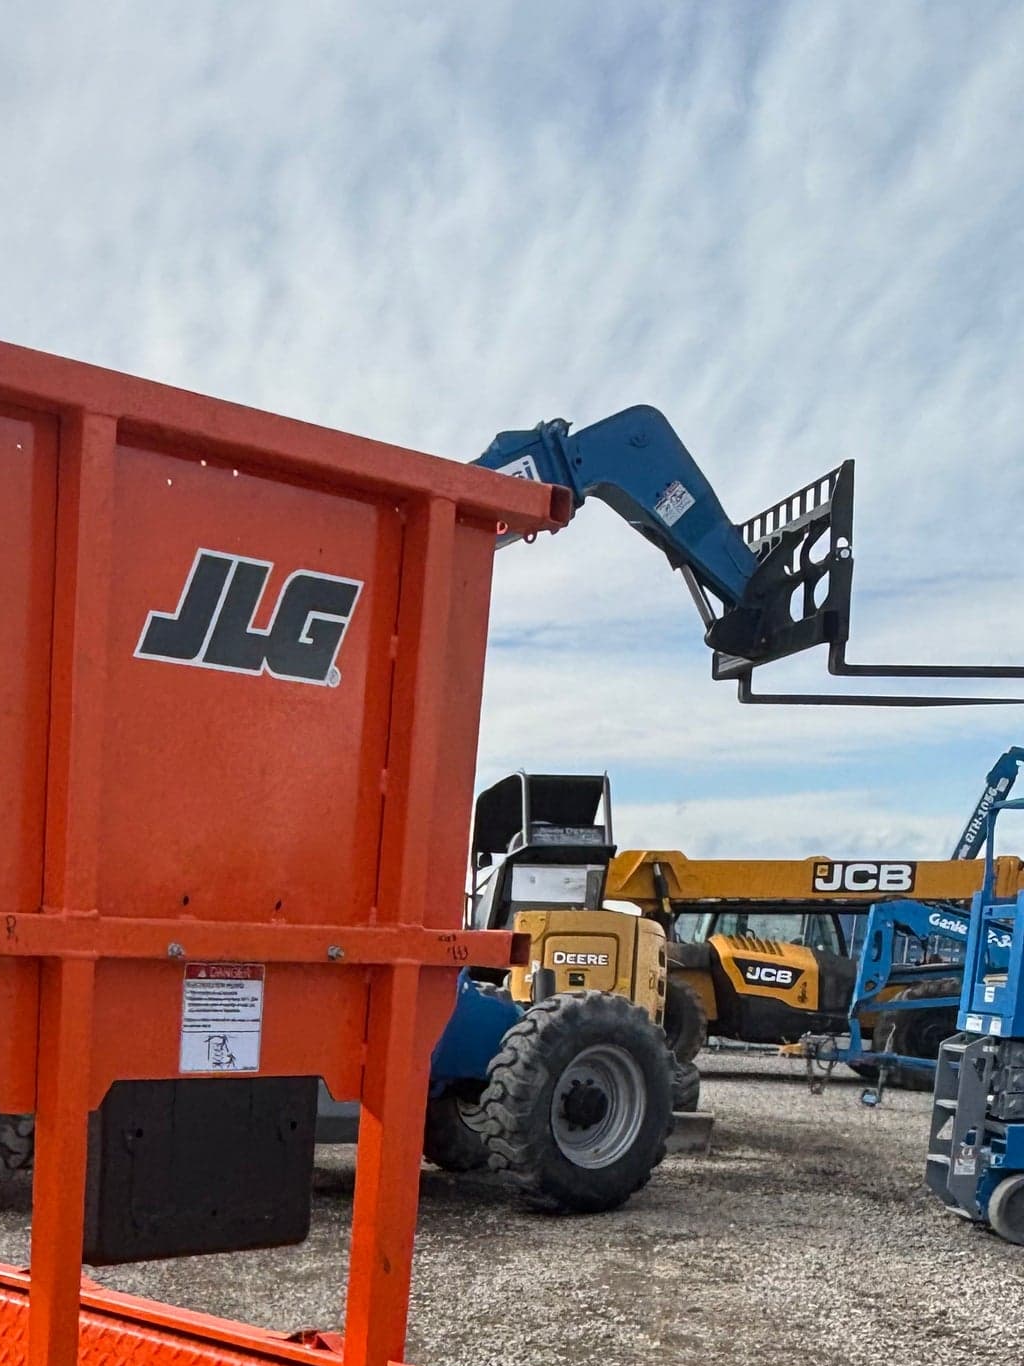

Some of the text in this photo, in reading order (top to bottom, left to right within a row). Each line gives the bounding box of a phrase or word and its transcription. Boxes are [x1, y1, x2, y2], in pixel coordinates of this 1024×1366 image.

[133, 548, 364, 687] JLG
[815, 864, 912, 891] JCB
[929, 913, 968, 935] Genie
[553, 951, 609, 965] DEERE
[745, 966, 793, 984] JCB
